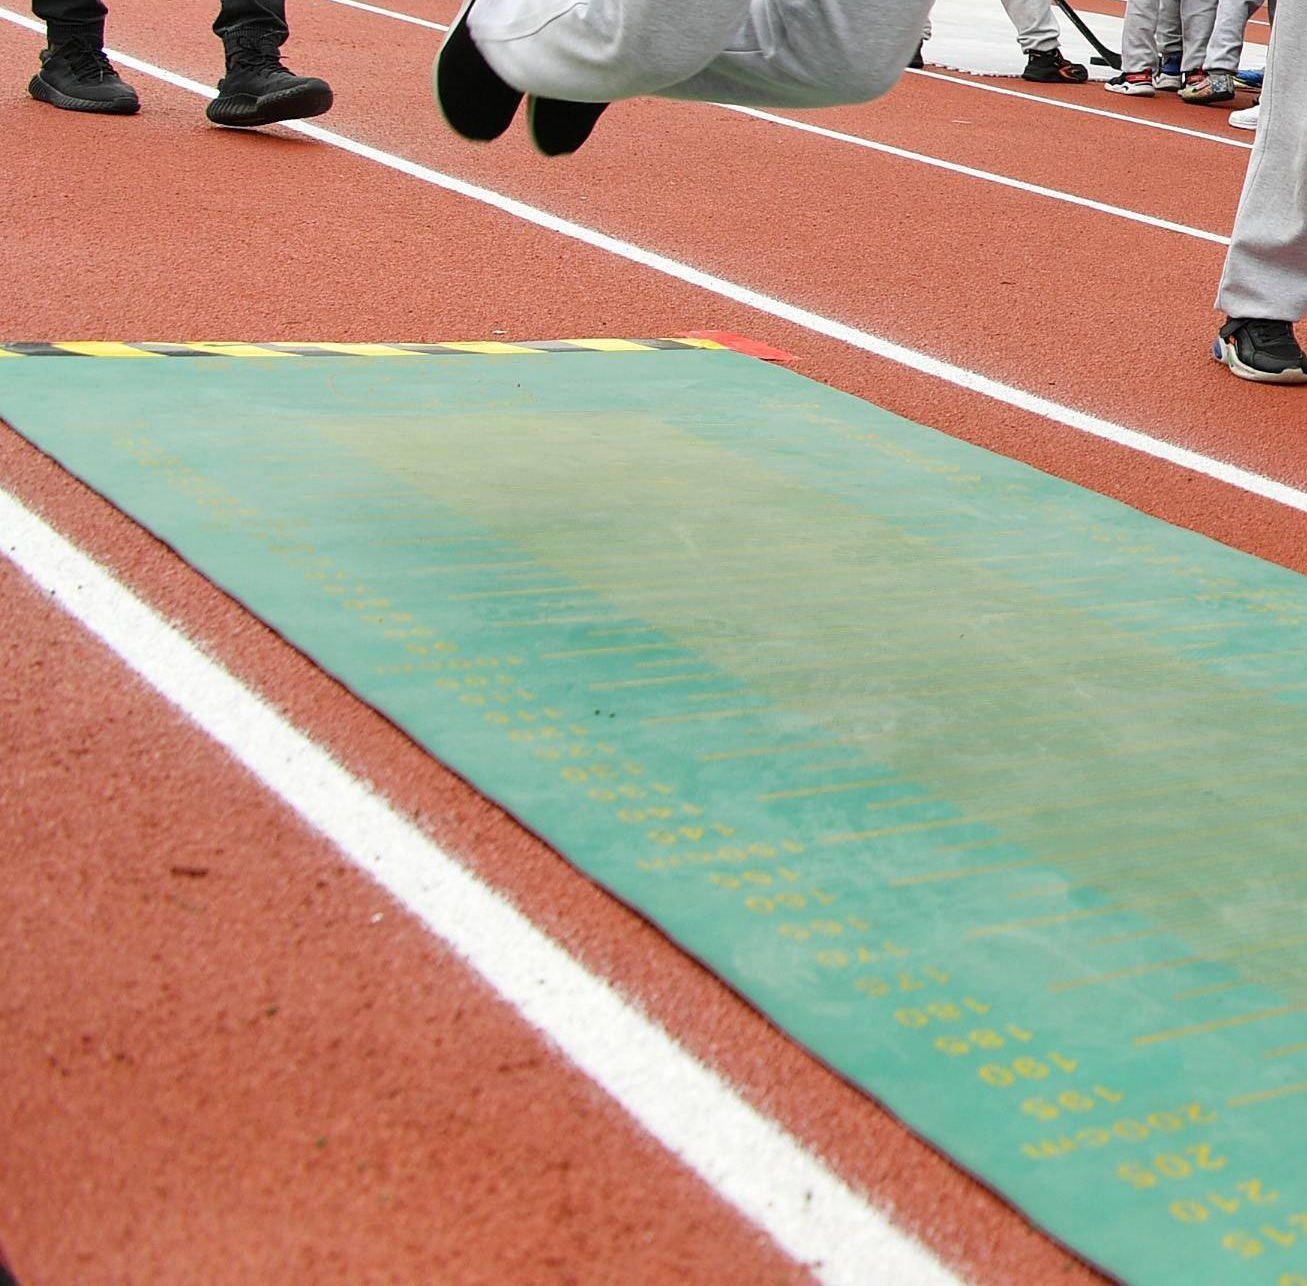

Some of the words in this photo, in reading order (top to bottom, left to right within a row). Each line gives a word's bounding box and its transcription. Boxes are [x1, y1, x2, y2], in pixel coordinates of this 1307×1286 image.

[894, 995, 993, 1030] 180
[932, 1022, 1034, 1058] 185
[977, 1051, 1078, 1089] 190
[1019, 1084, 1126, 1122] 195
[1113, 1143, 1229, 1192] 205
[1167, 1178, 1281, 1223] 210
